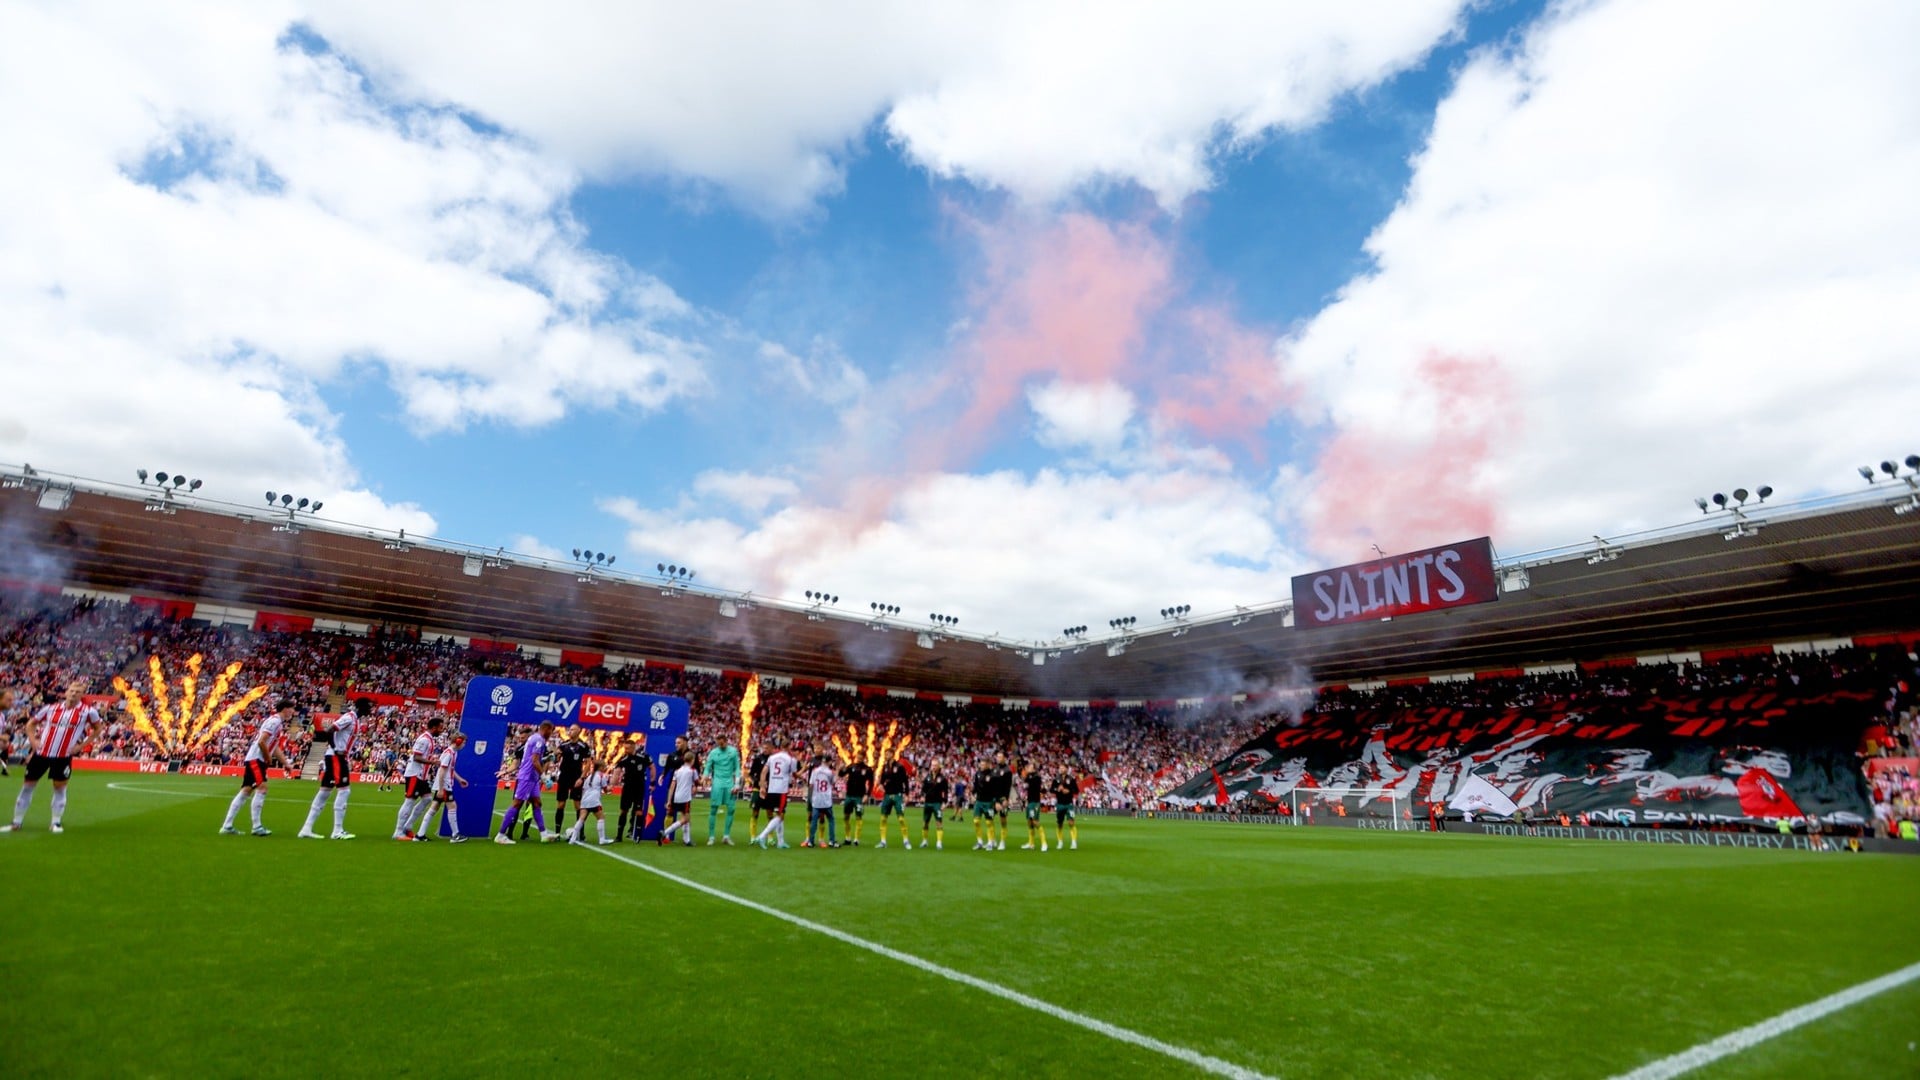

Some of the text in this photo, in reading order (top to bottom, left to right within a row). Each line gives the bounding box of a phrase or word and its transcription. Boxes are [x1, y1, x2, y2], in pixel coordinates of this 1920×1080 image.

[1313, 549, 1465, 622] SAINTS
[490, 705, 508, 716] EFL
[534, 692, 626, 719] sky bet
[650, 720, 666, 730] EFL
[140, 762, 222, 775] WE MCH ON
[774, 762, 781, 775] 5
[816, 779, 828, 792] 18
[1594, 829, 1684, 844] TOUCHES
[1688, 832, 1710, 846] IN
[1715, 833, 1786, 850] EVERY
